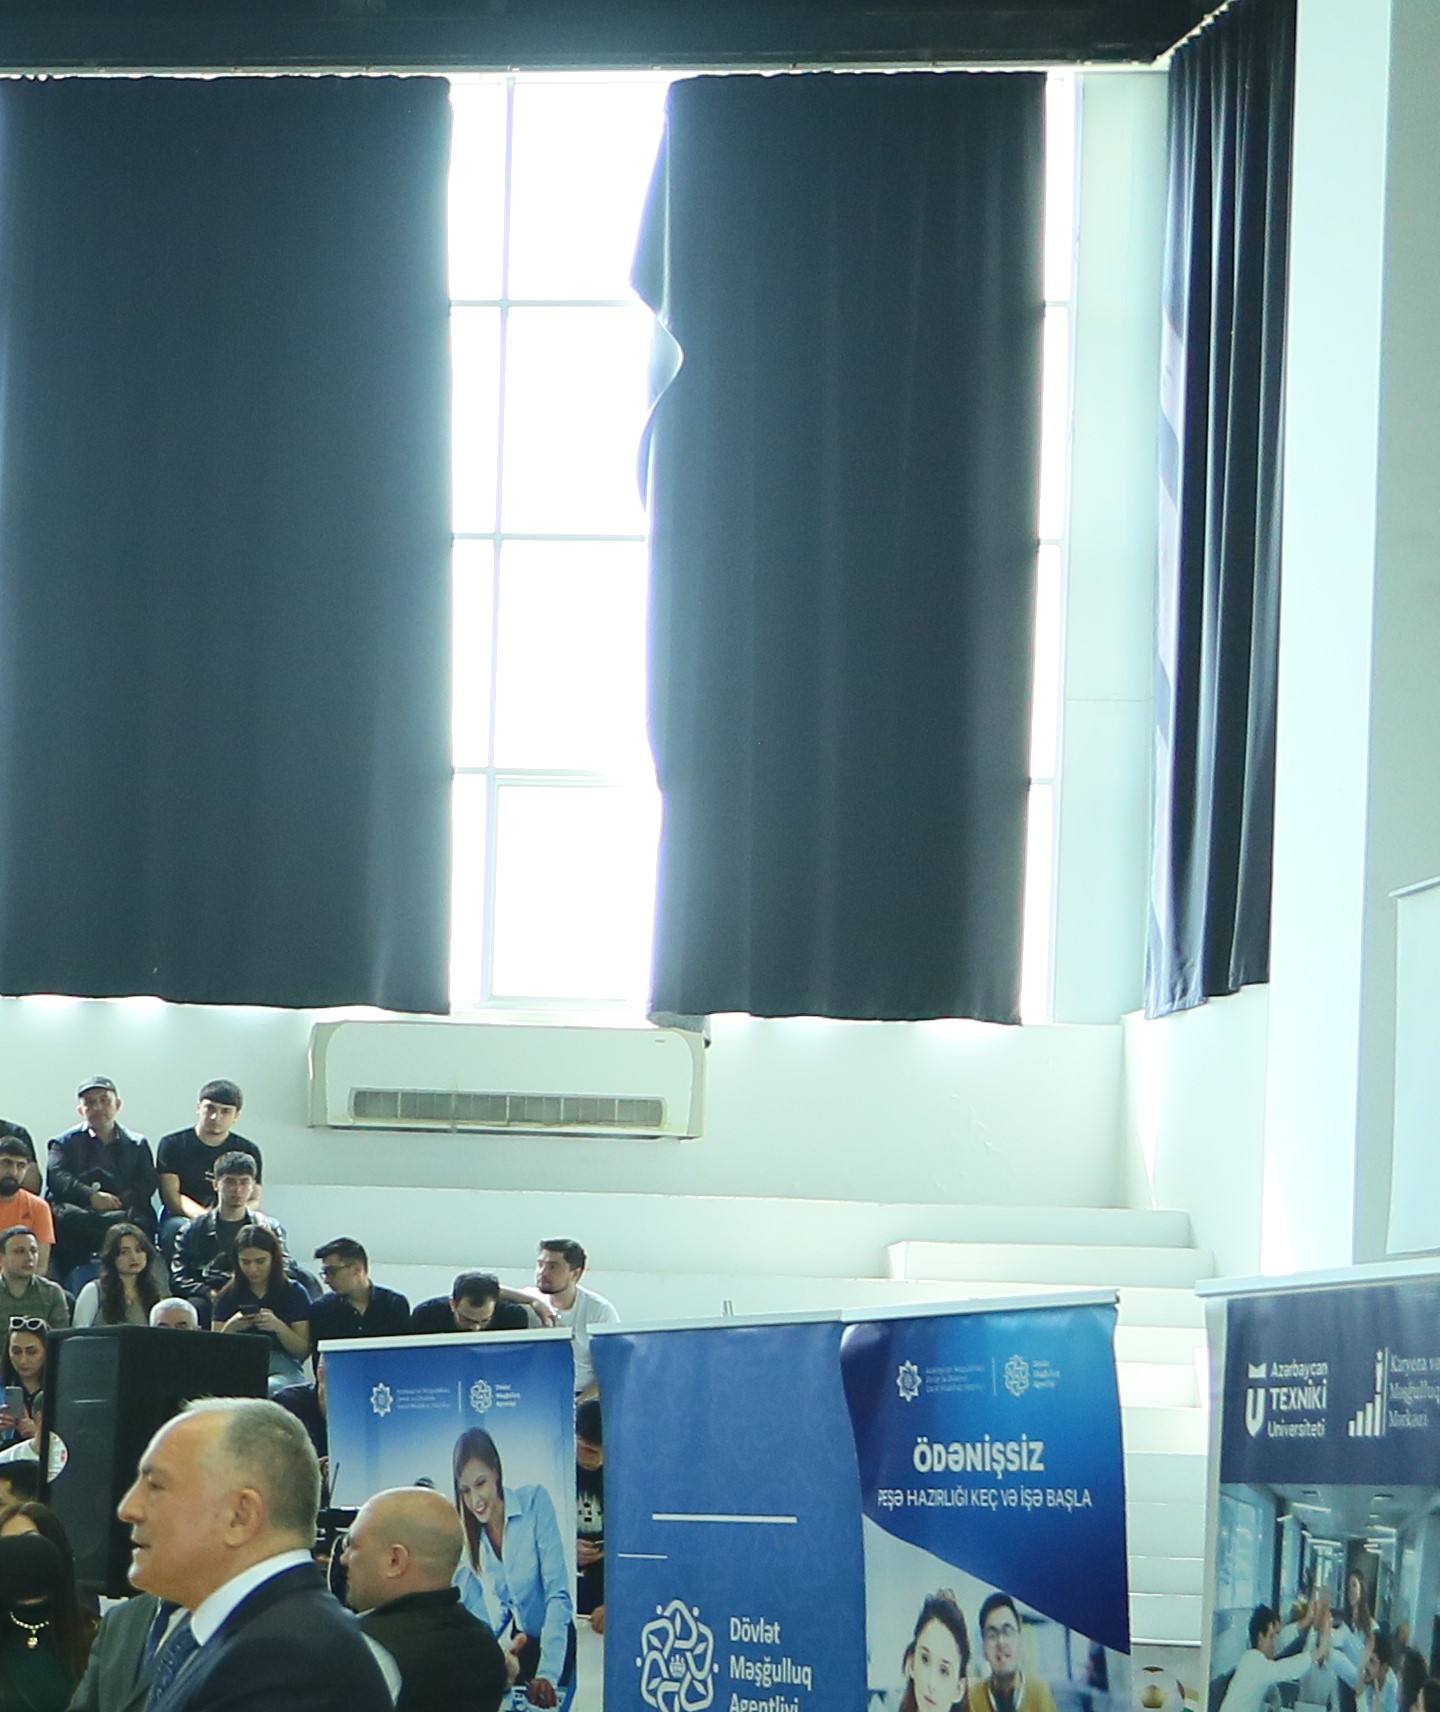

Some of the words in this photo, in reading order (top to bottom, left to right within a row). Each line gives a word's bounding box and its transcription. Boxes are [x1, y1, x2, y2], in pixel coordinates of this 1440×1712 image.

[1270, 1378, 1327, 1410] TEXNİKİ
[913, 1433, 1045, 1479] ÖDƏNİŞSİZ
[877, 1487, 904, 1511] PEŞƏ
[906, 1484, 969, 1508] HAZIRLIĞI
[971, 1488, 998, 1511] KEÇ
[1000, 1488, 1017, 1507] VƏ
[1020, 1485, 1043, 1511] İŞƏ
[1046, 1488, 1093, 1512] BAŞLA
[729, 1616, 781, 1645] Dövlət
[729, 1654, 813, 1691] Məşğulluq
